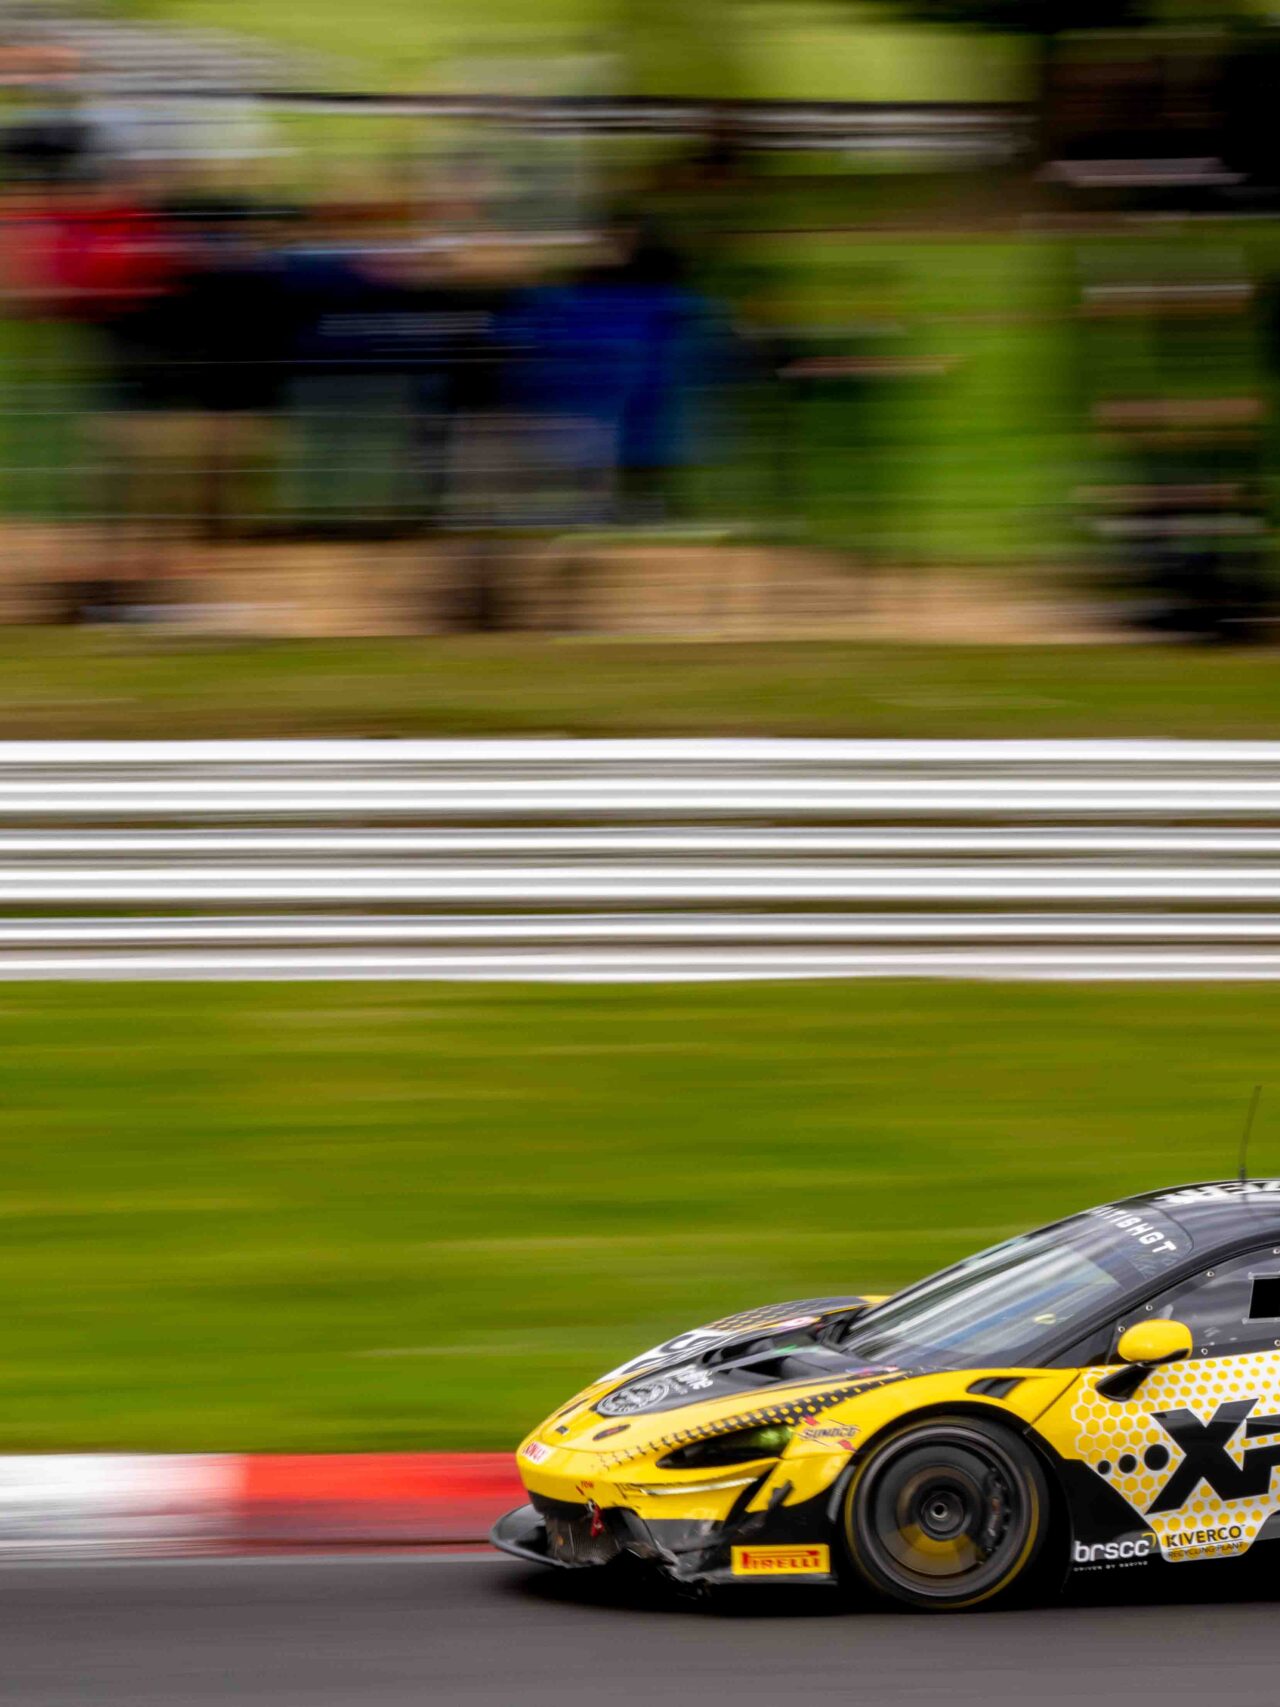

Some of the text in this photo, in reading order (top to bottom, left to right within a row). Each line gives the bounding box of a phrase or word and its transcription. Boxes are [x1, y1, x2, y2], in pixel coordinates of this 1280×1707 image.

[1166, 1526, 1242, 1548] KIVERCO
[742, 1550, 820, 1569] PIRELLI
[1074, 1540, 1150, 1563] brscc
